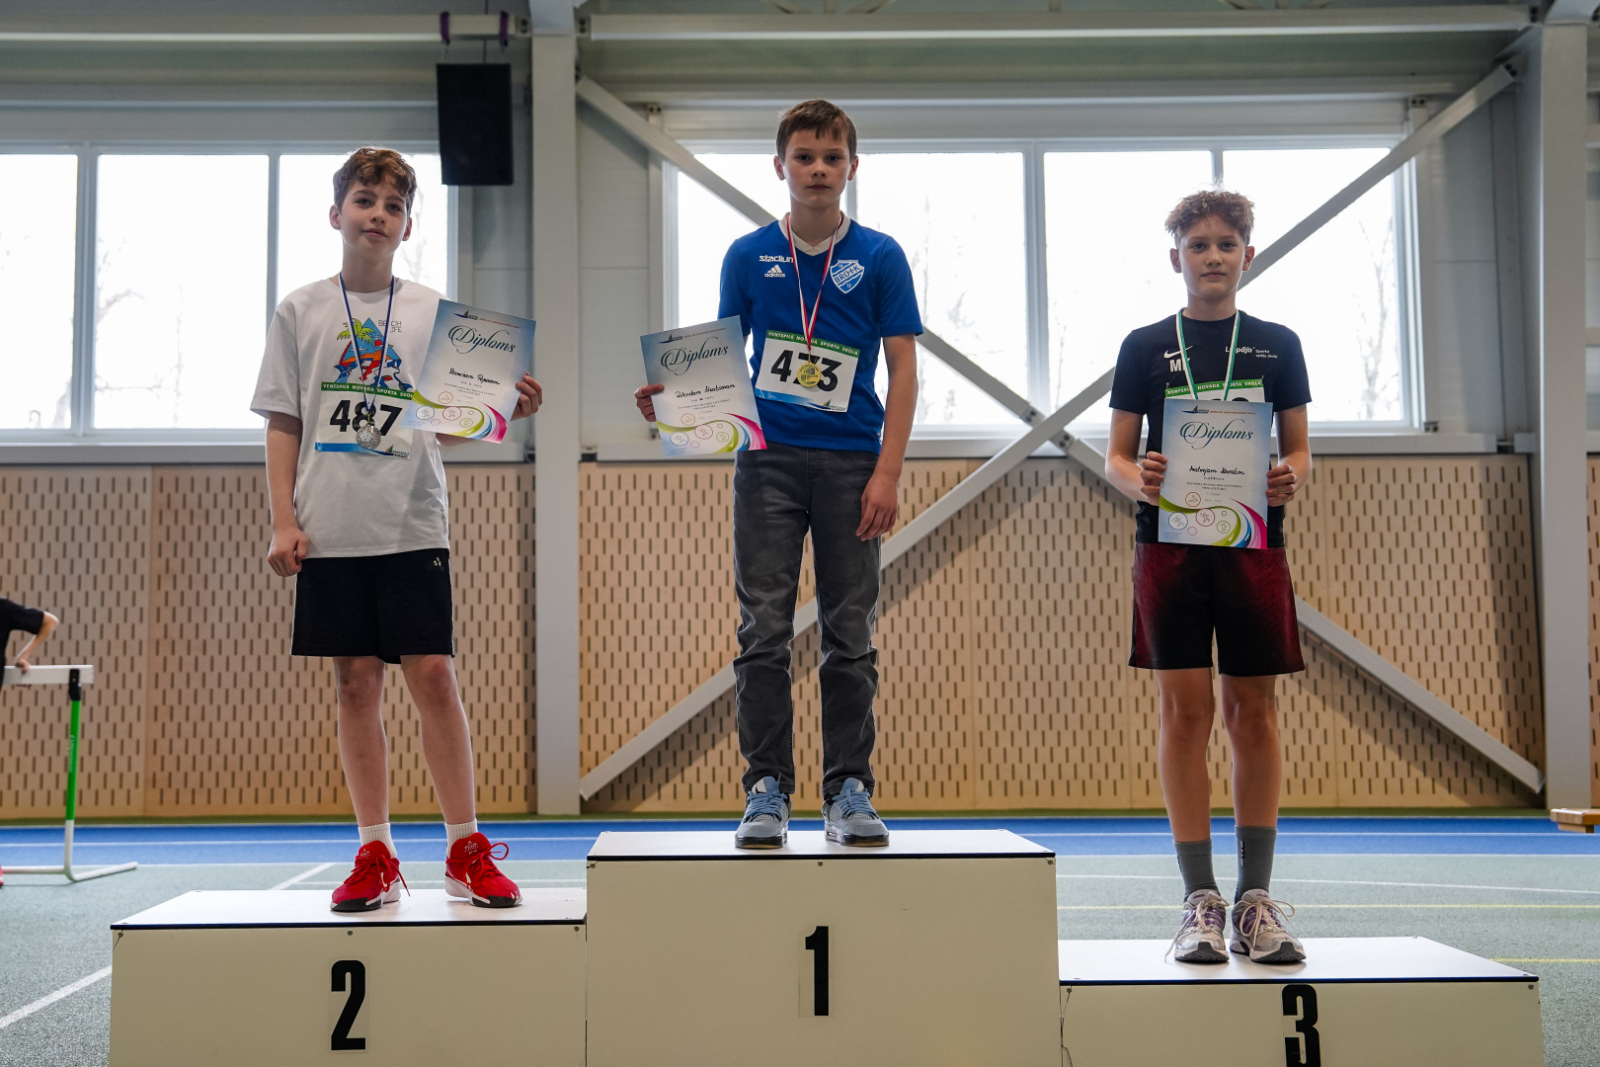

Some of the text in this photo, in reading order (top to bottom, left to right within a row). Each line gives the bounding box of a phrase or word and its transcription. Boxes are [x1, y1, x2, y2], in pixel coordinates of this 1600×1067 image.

[448, 324, 516, 354] Diploms
[660, 336, 729, 376] Diploms
[768, 331, 794, 340] VENTSPILS
[820, 341, 840, 350] SPORTA
[842, 347, 858, 356] SKOLA
[377, 387, 398, 396] SPORTA
[329, 399, 403, 437] 487
[1179, 418, 1254, 450] Diploms
[805, 926, 829, 1016] 1
[331, 960, 366, 1050] 2
[1281, 984, 1322, 1067] 3
